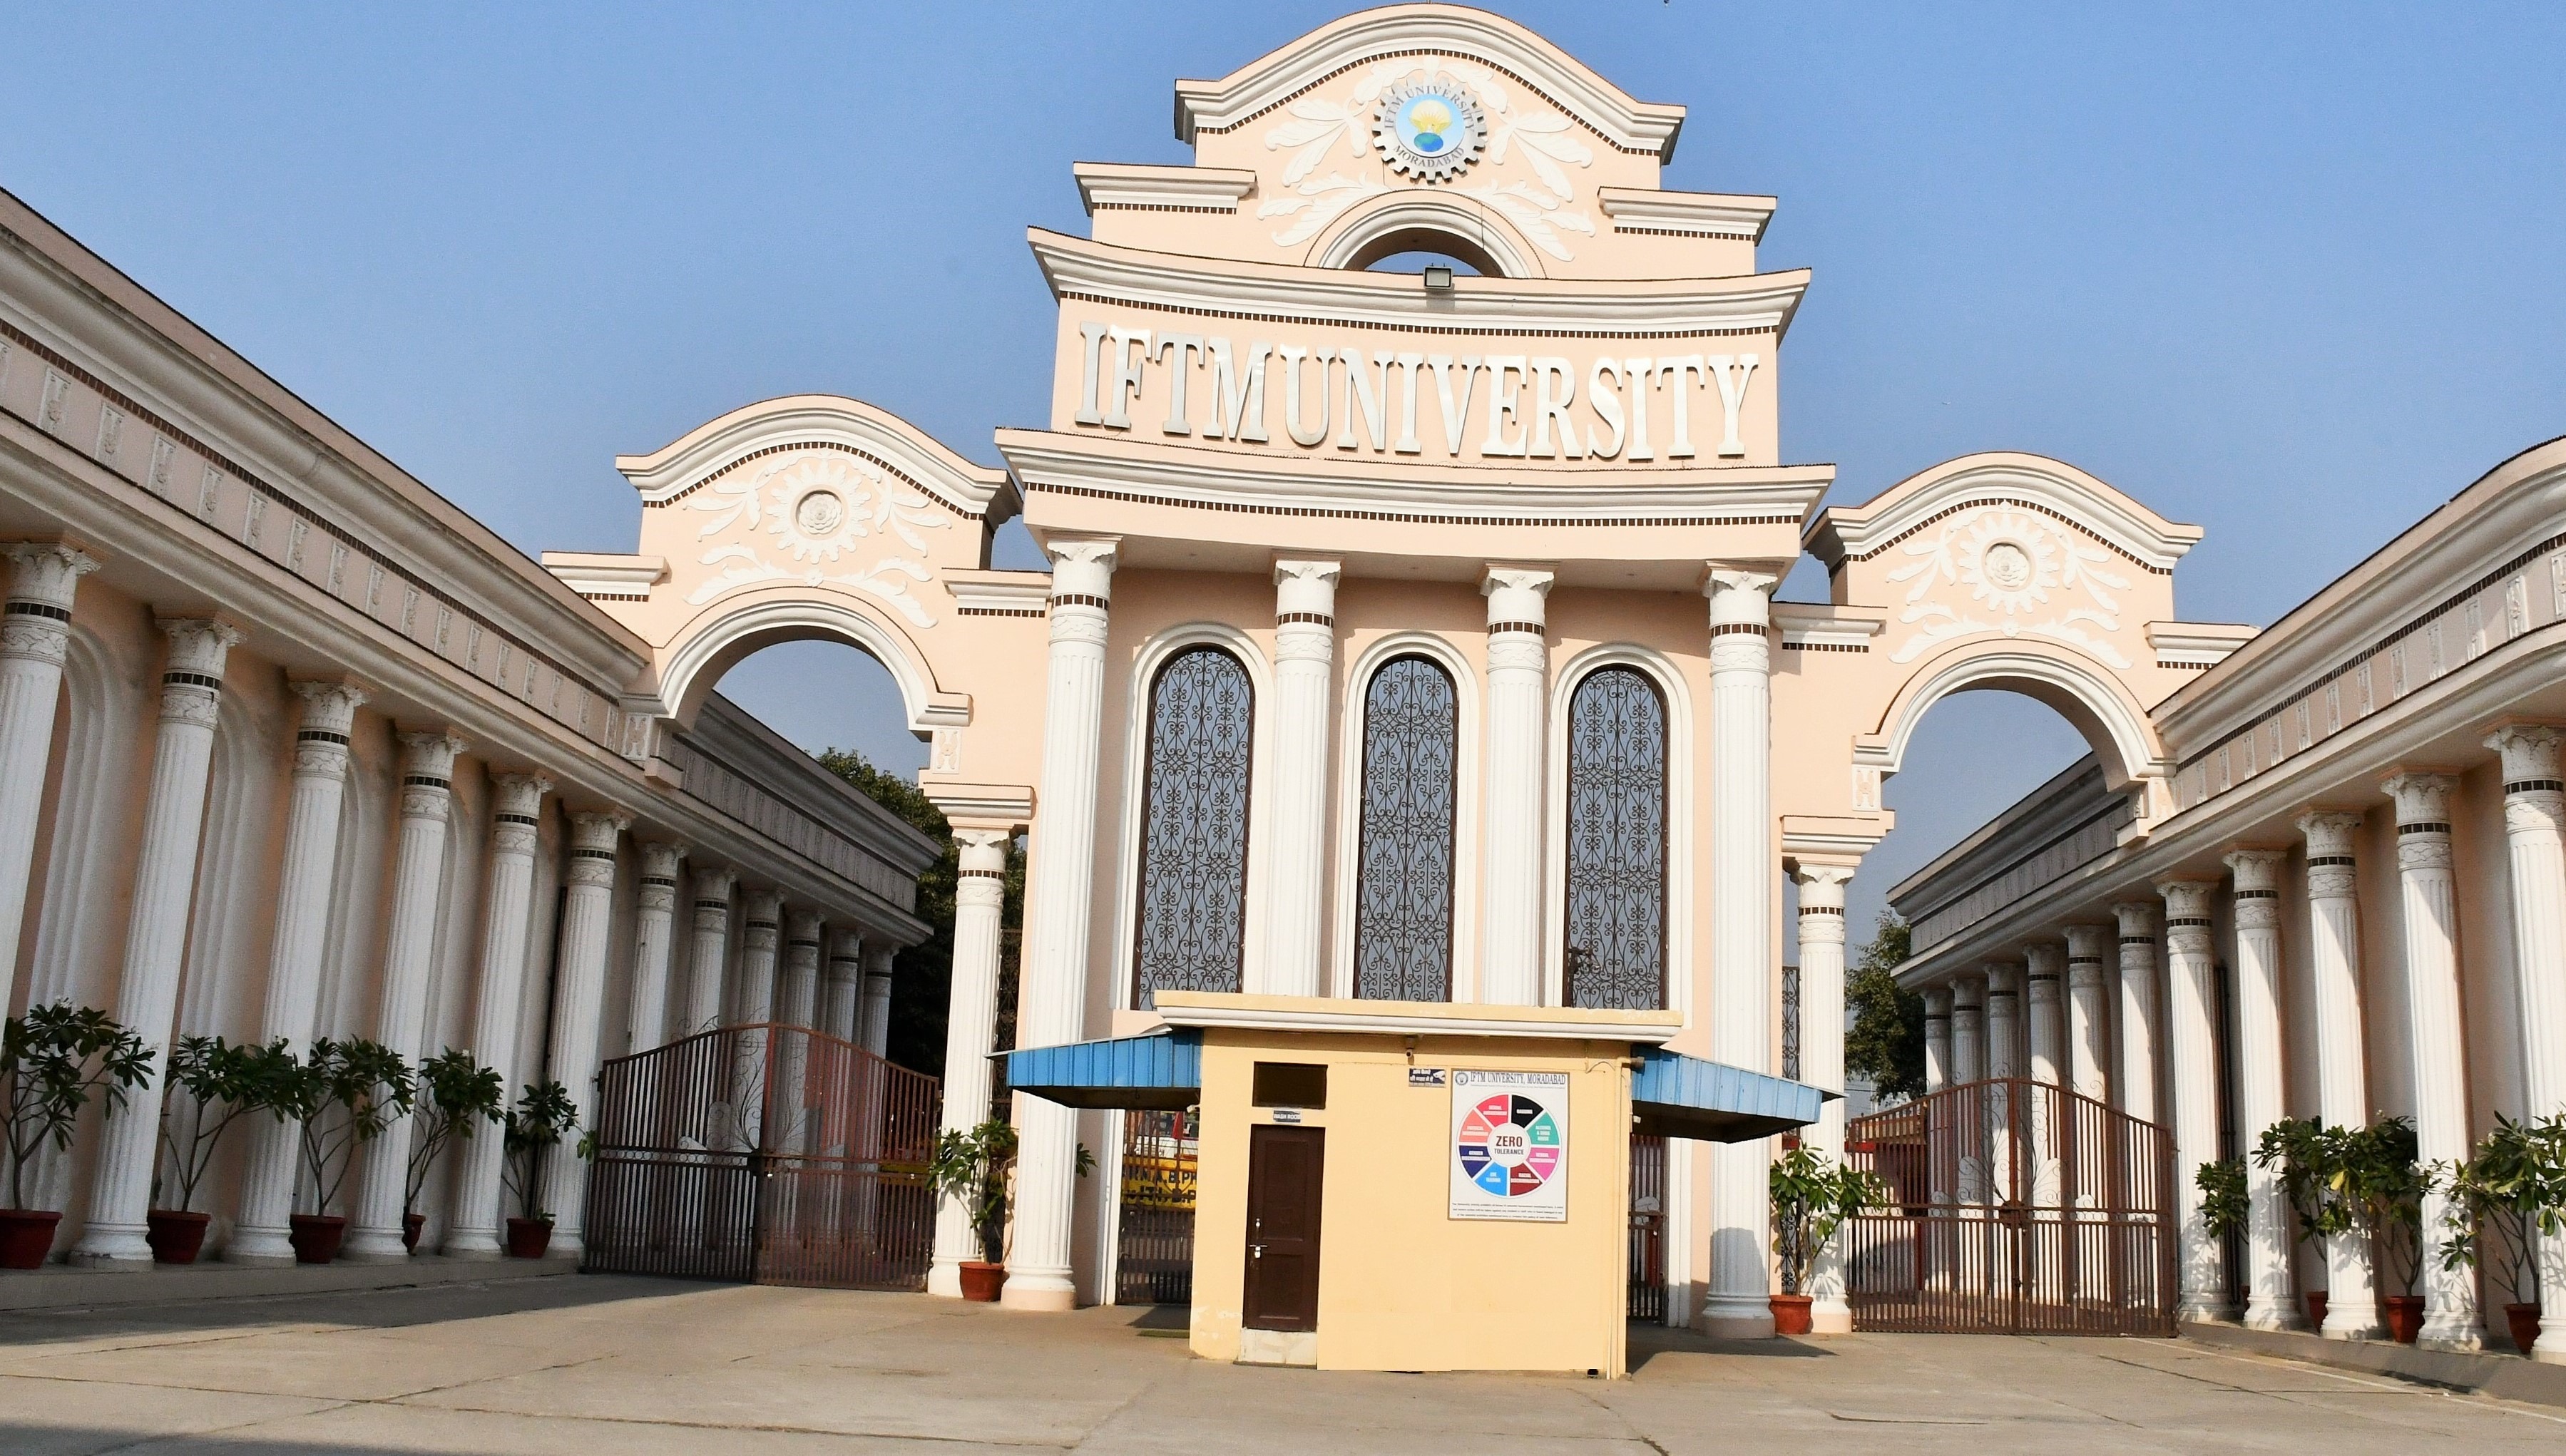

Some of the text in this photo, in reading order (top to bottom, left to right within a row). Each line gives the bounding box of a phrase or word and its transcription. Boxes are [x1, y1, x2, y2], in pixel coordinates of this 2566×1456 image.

[1384, 85, 1475, 131] IFTM UNIVERSITY
[1394, 145, 1464, 168] MORADABAD
[1471, 1071, 1566, 1085] IFTM UNIVERSITY, MORADABAD
[1496, 1135, 1523, 1147] ZERO
